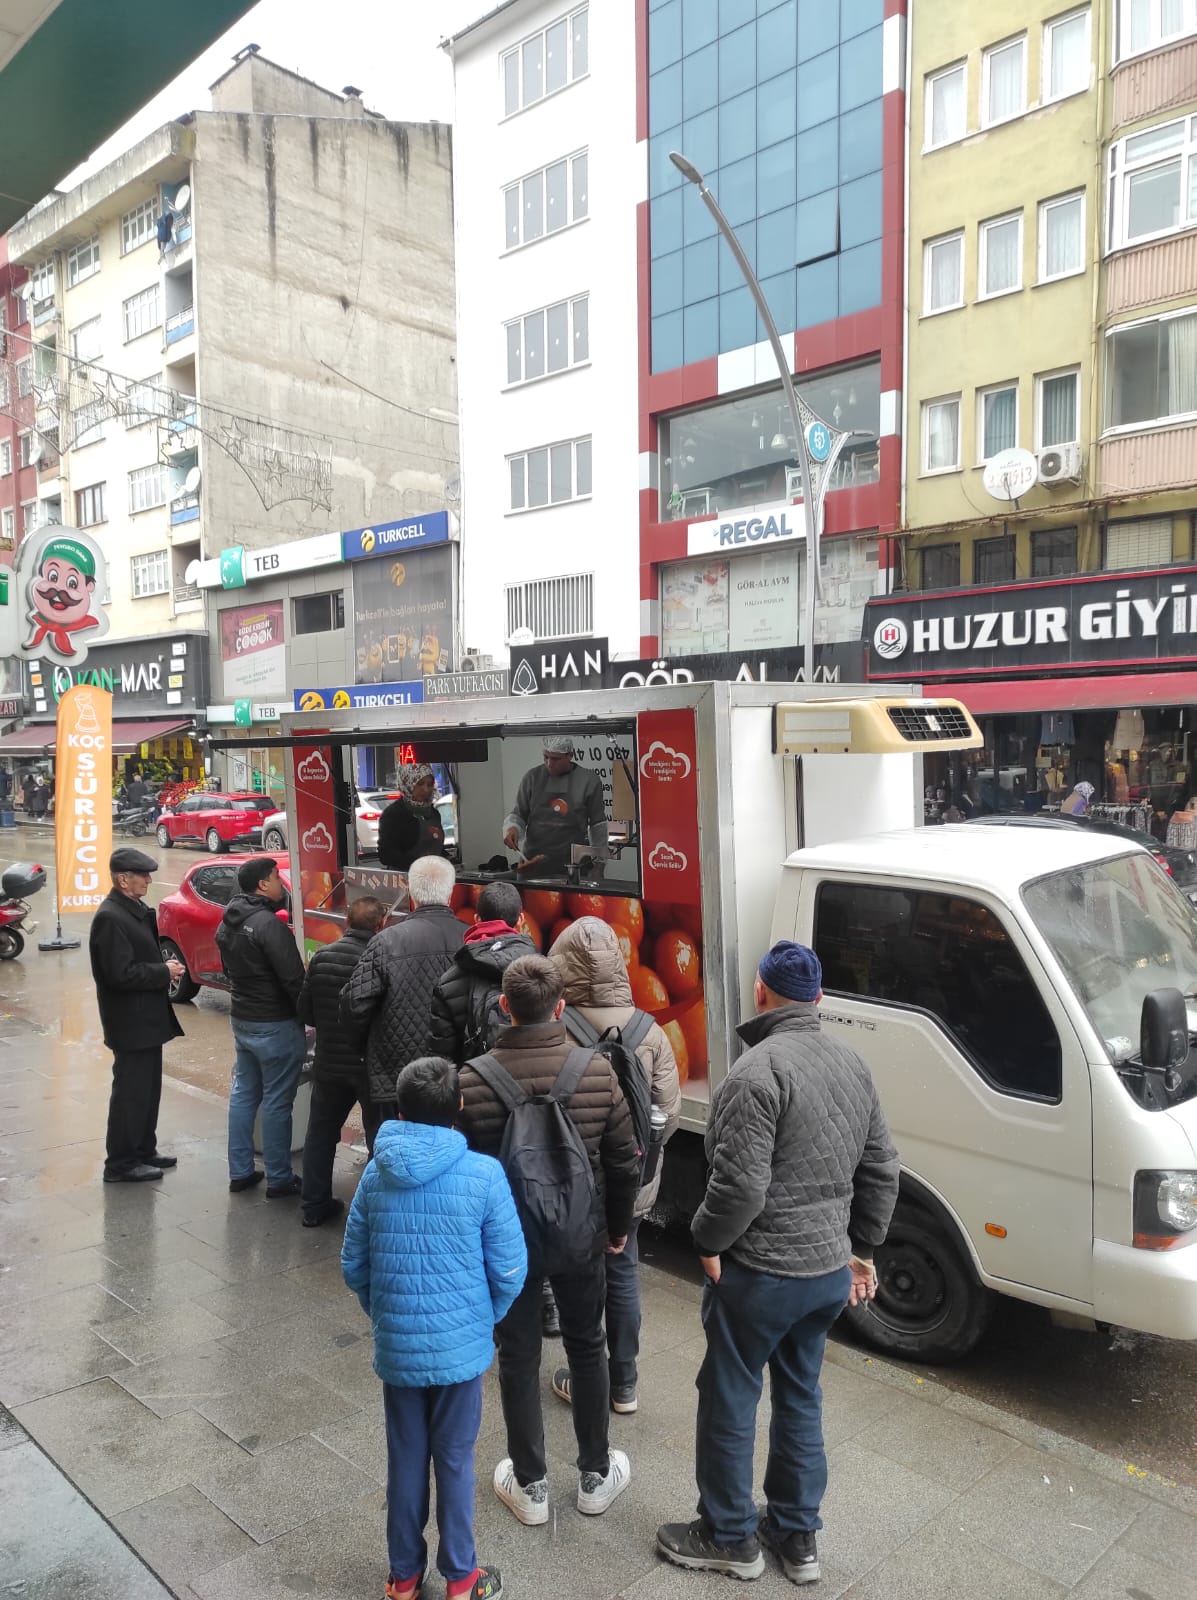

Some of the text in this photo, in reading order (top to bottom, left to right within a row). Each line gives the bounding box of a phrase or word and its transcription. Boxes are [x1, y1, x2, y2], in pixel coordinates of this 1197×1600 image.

[378, 523, 426, 545] TURKCELL
[720, 513, 793, 546] REGAL
[254, 553, 280, 572] TEB
[737, 576, 790, 591] GÖR-AL AVM
[884, 628, 896, 641] H
[912, 606, 1070, 654] HUZUR
[541, 650, 601, 678] HAN
[77, 662, 163, 693] KAN-MAR
[427, 673, 504, 695] PARK YUFKACISI
[259, 707, 276, 718] TEB
[68, 734, 105, 751] KOÇ
[74, 752, 99, 892] SÜRÜCÜ
